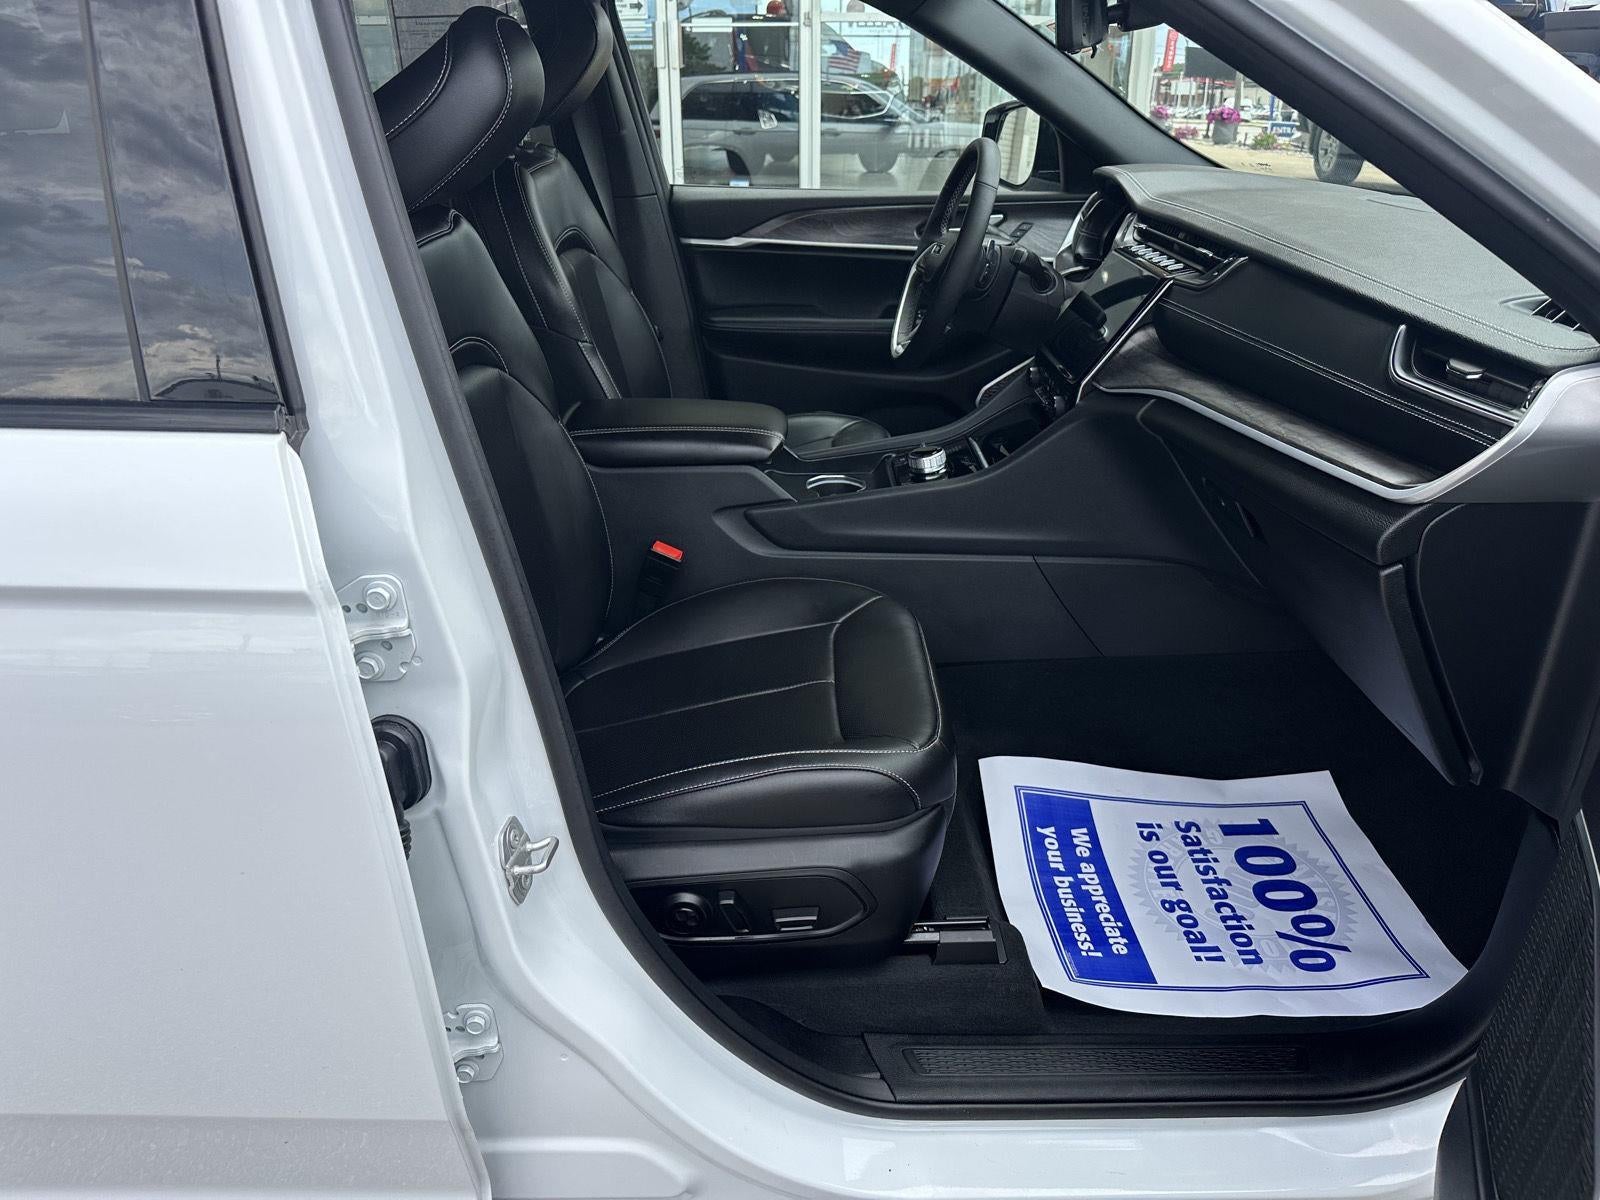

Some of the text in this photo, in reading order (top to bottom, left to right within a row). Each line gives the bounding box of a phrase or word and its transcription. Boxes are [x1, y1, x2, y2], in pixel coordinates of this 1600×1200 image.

[1036, 826, 1066, 872] your
[1053, 876, 1103, 957] business!
[1070, 827, 1128, 955] We appreciate
[1136, 822, 1226, 962] is our goal!
[1174, 821, 1264, 965] Satisfaction
[1218, 818, 1352, 972] 100%
